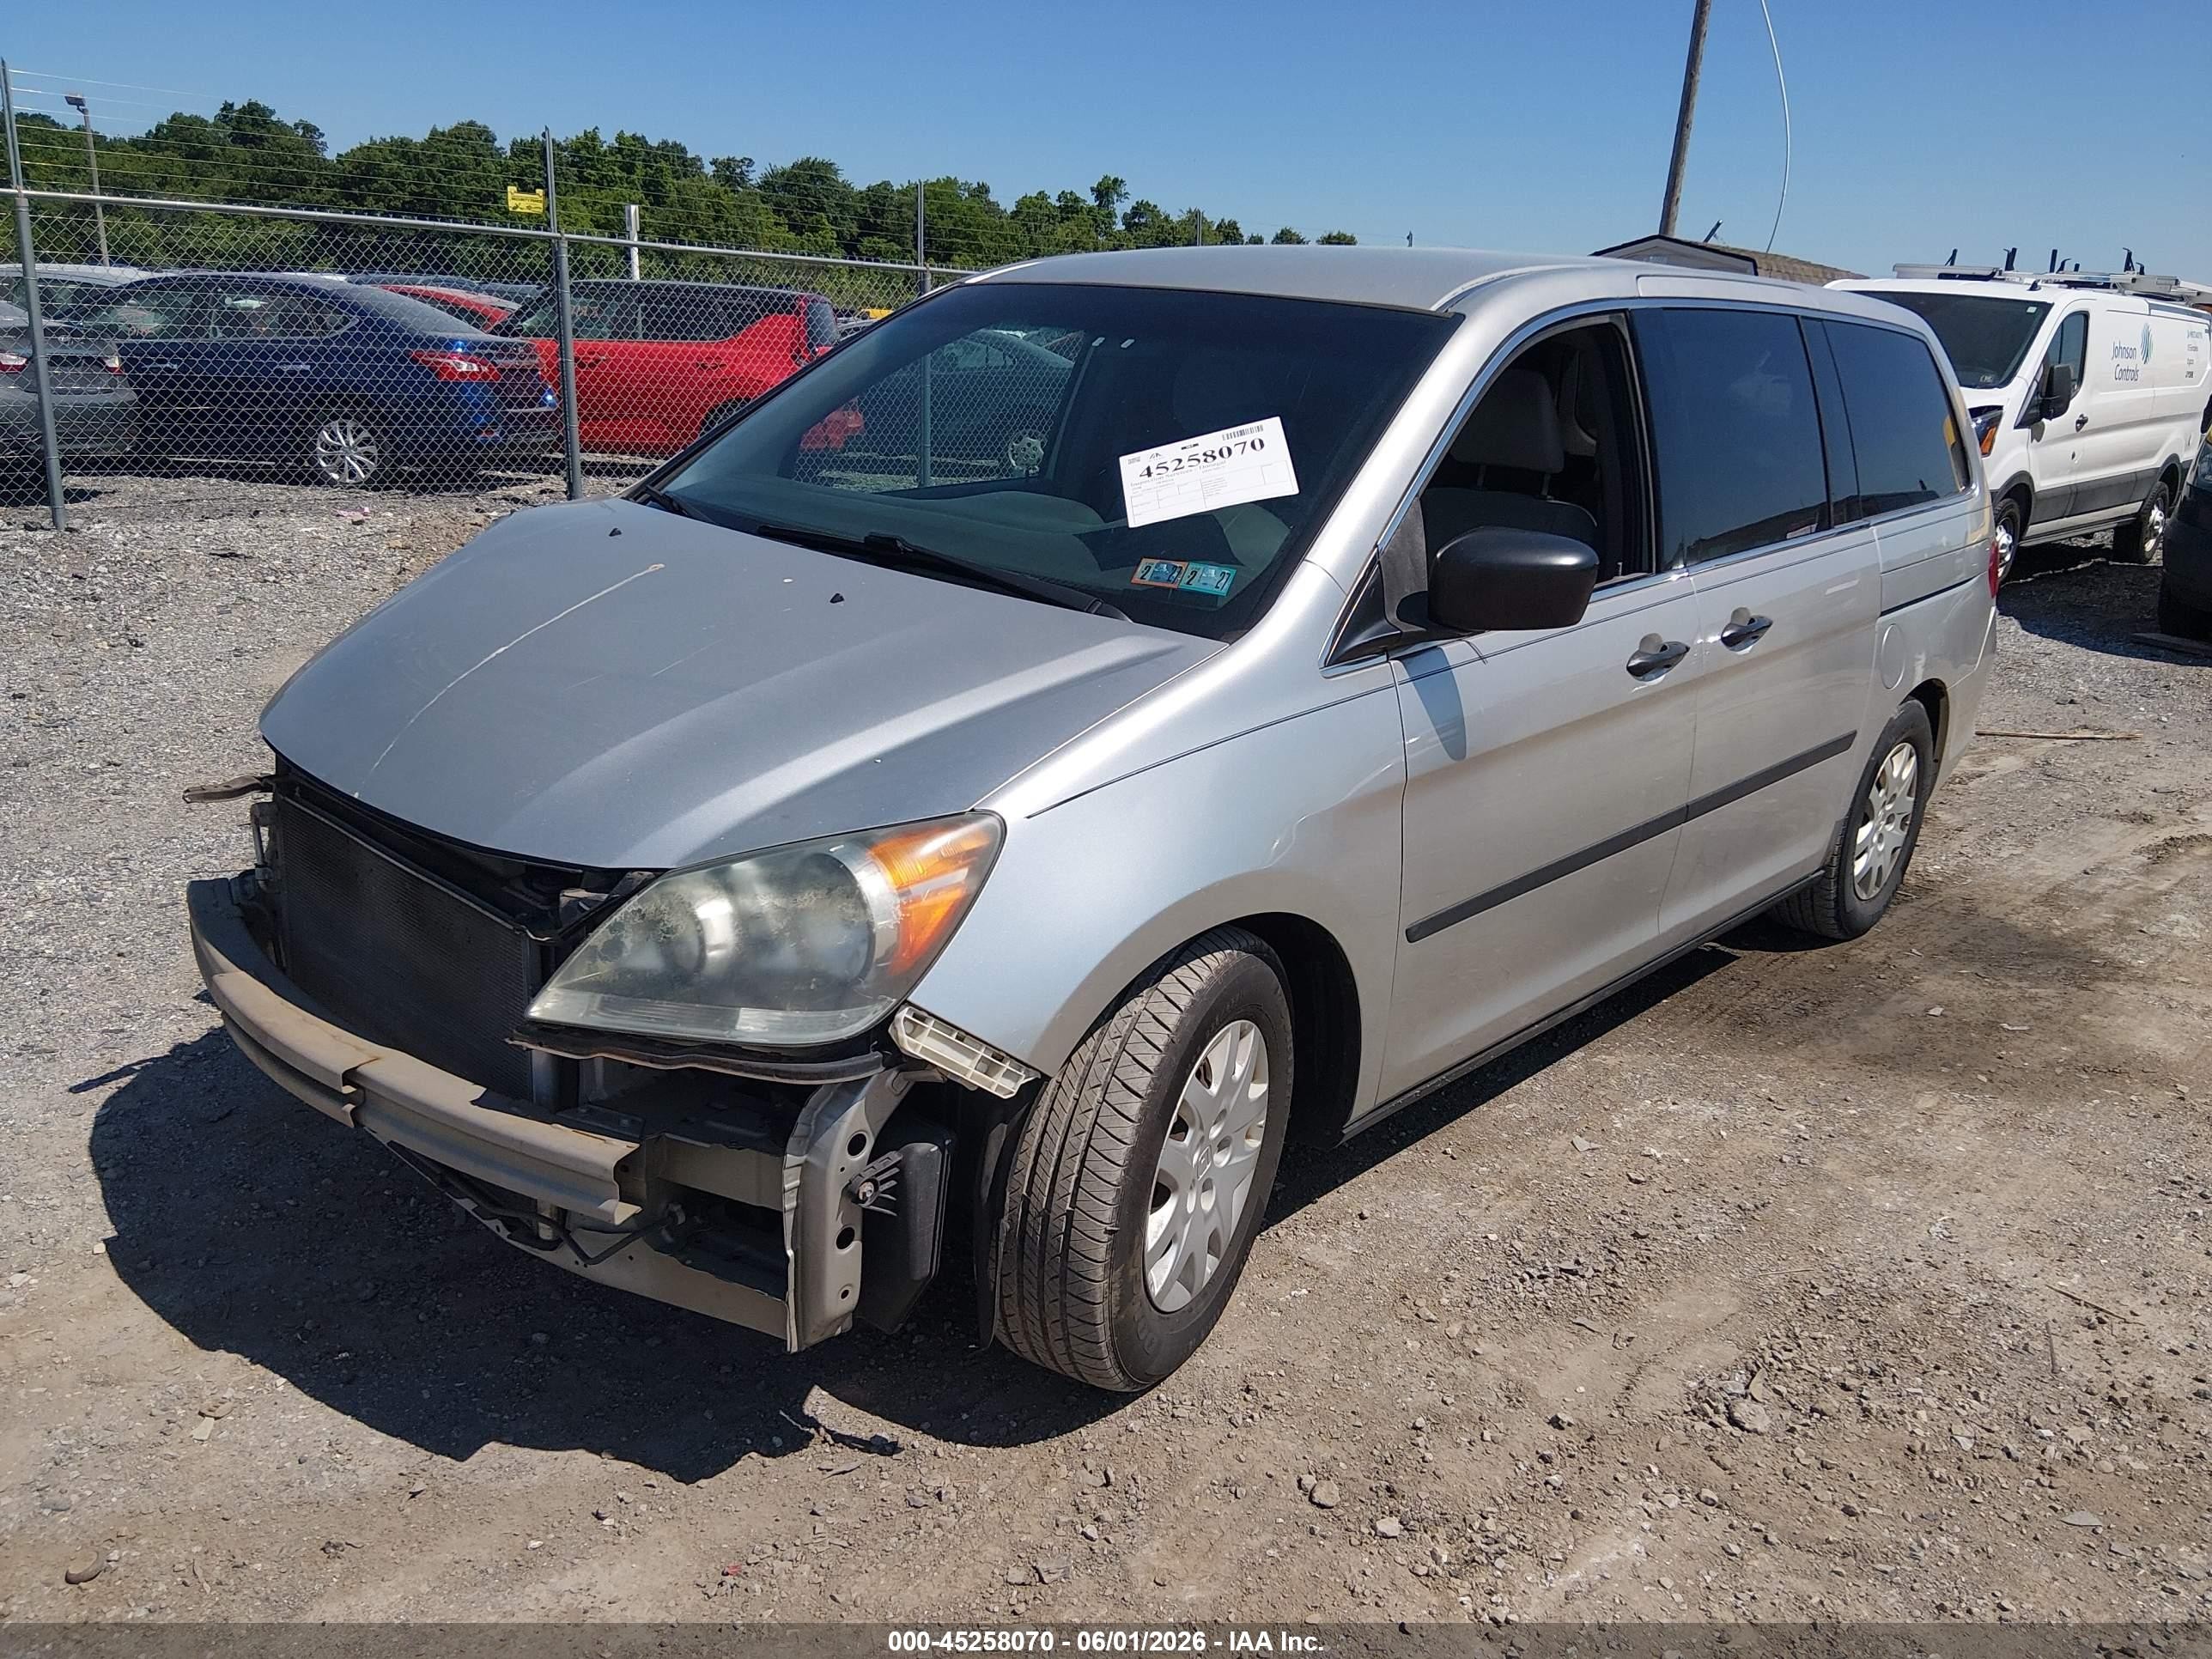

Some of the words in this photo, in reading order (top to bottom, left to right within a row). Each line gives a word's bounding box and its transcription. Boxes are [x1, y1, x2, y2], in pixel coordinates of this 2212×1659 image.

[2112, 341, 2137, 361] Johnson
[2114, 364, 2140, 381] Controls
[1139, 438, 1265, 478] 45258070
[1215, 571, 1231, 591] 27
